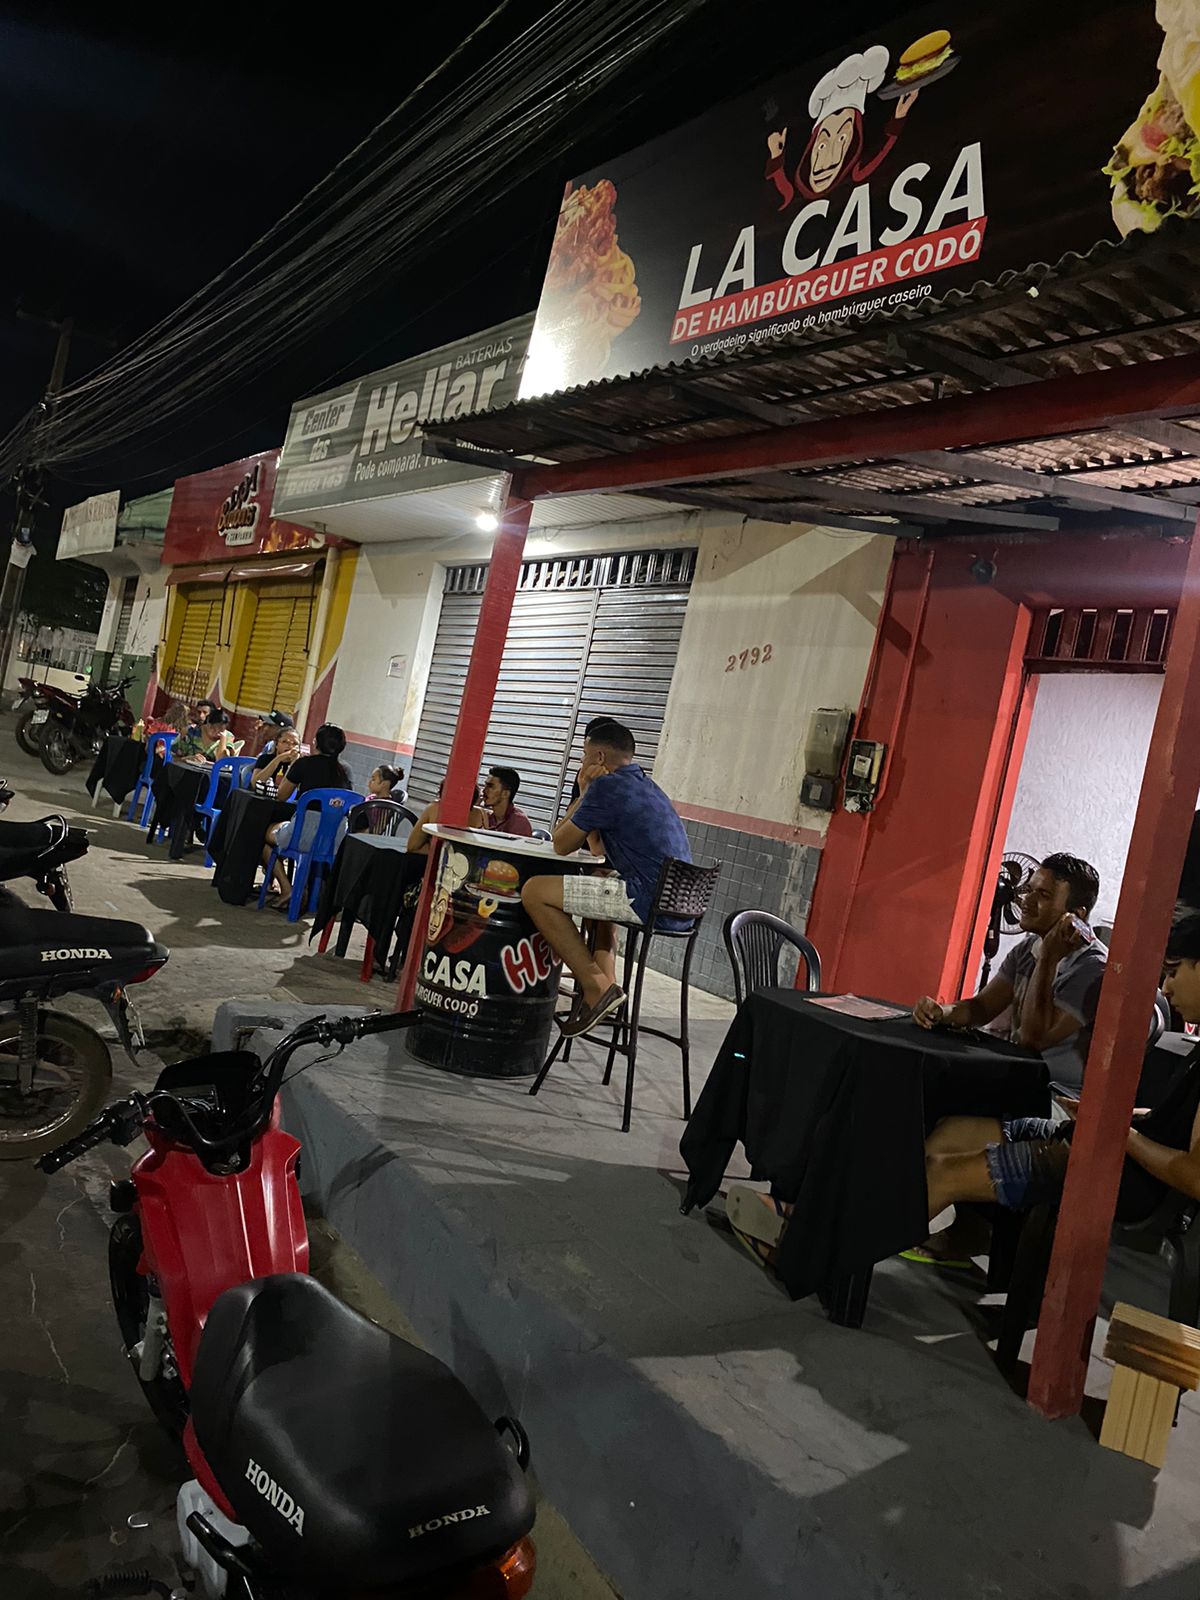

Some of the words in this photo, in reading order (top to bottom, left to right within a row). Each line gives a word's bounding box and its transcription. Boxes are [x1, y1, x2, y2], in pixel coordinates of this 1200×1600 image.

[678, 225, 755, 310] LA
[782, 141, 985, 276] CASA
[671, 312, 703, 342] DE
[707, 257, 888, 332] HAMBÚRGUER
[894, 222, 982, 278] CODÓ
[691, 344, 699, 357] O
[700, 333, 747, 356] verdadeiro
[748, 315, 801, 342] significado
[802, 314, 816, 327] do
[818, 299, 887, 325] hambúrguer
[888, 284, 932, 305] caseiro
[456, 336, 513, 370] BATERIAS
[302, 404, 346, 436] Center
[359, 358, 507, 457] Heliar
[309, 438, 331, 462] das
[354, 460, 375, 482] Pode
[725, 644, 773, 672] 2792
[41, 948, 112, 962] HONDA
[424, 951, 487, 999] CASA
[501, 931, 562, 994] HE
[245, 1459, 305, 1536] HONDA
[408, 1505, 491, 1539] HONDA
